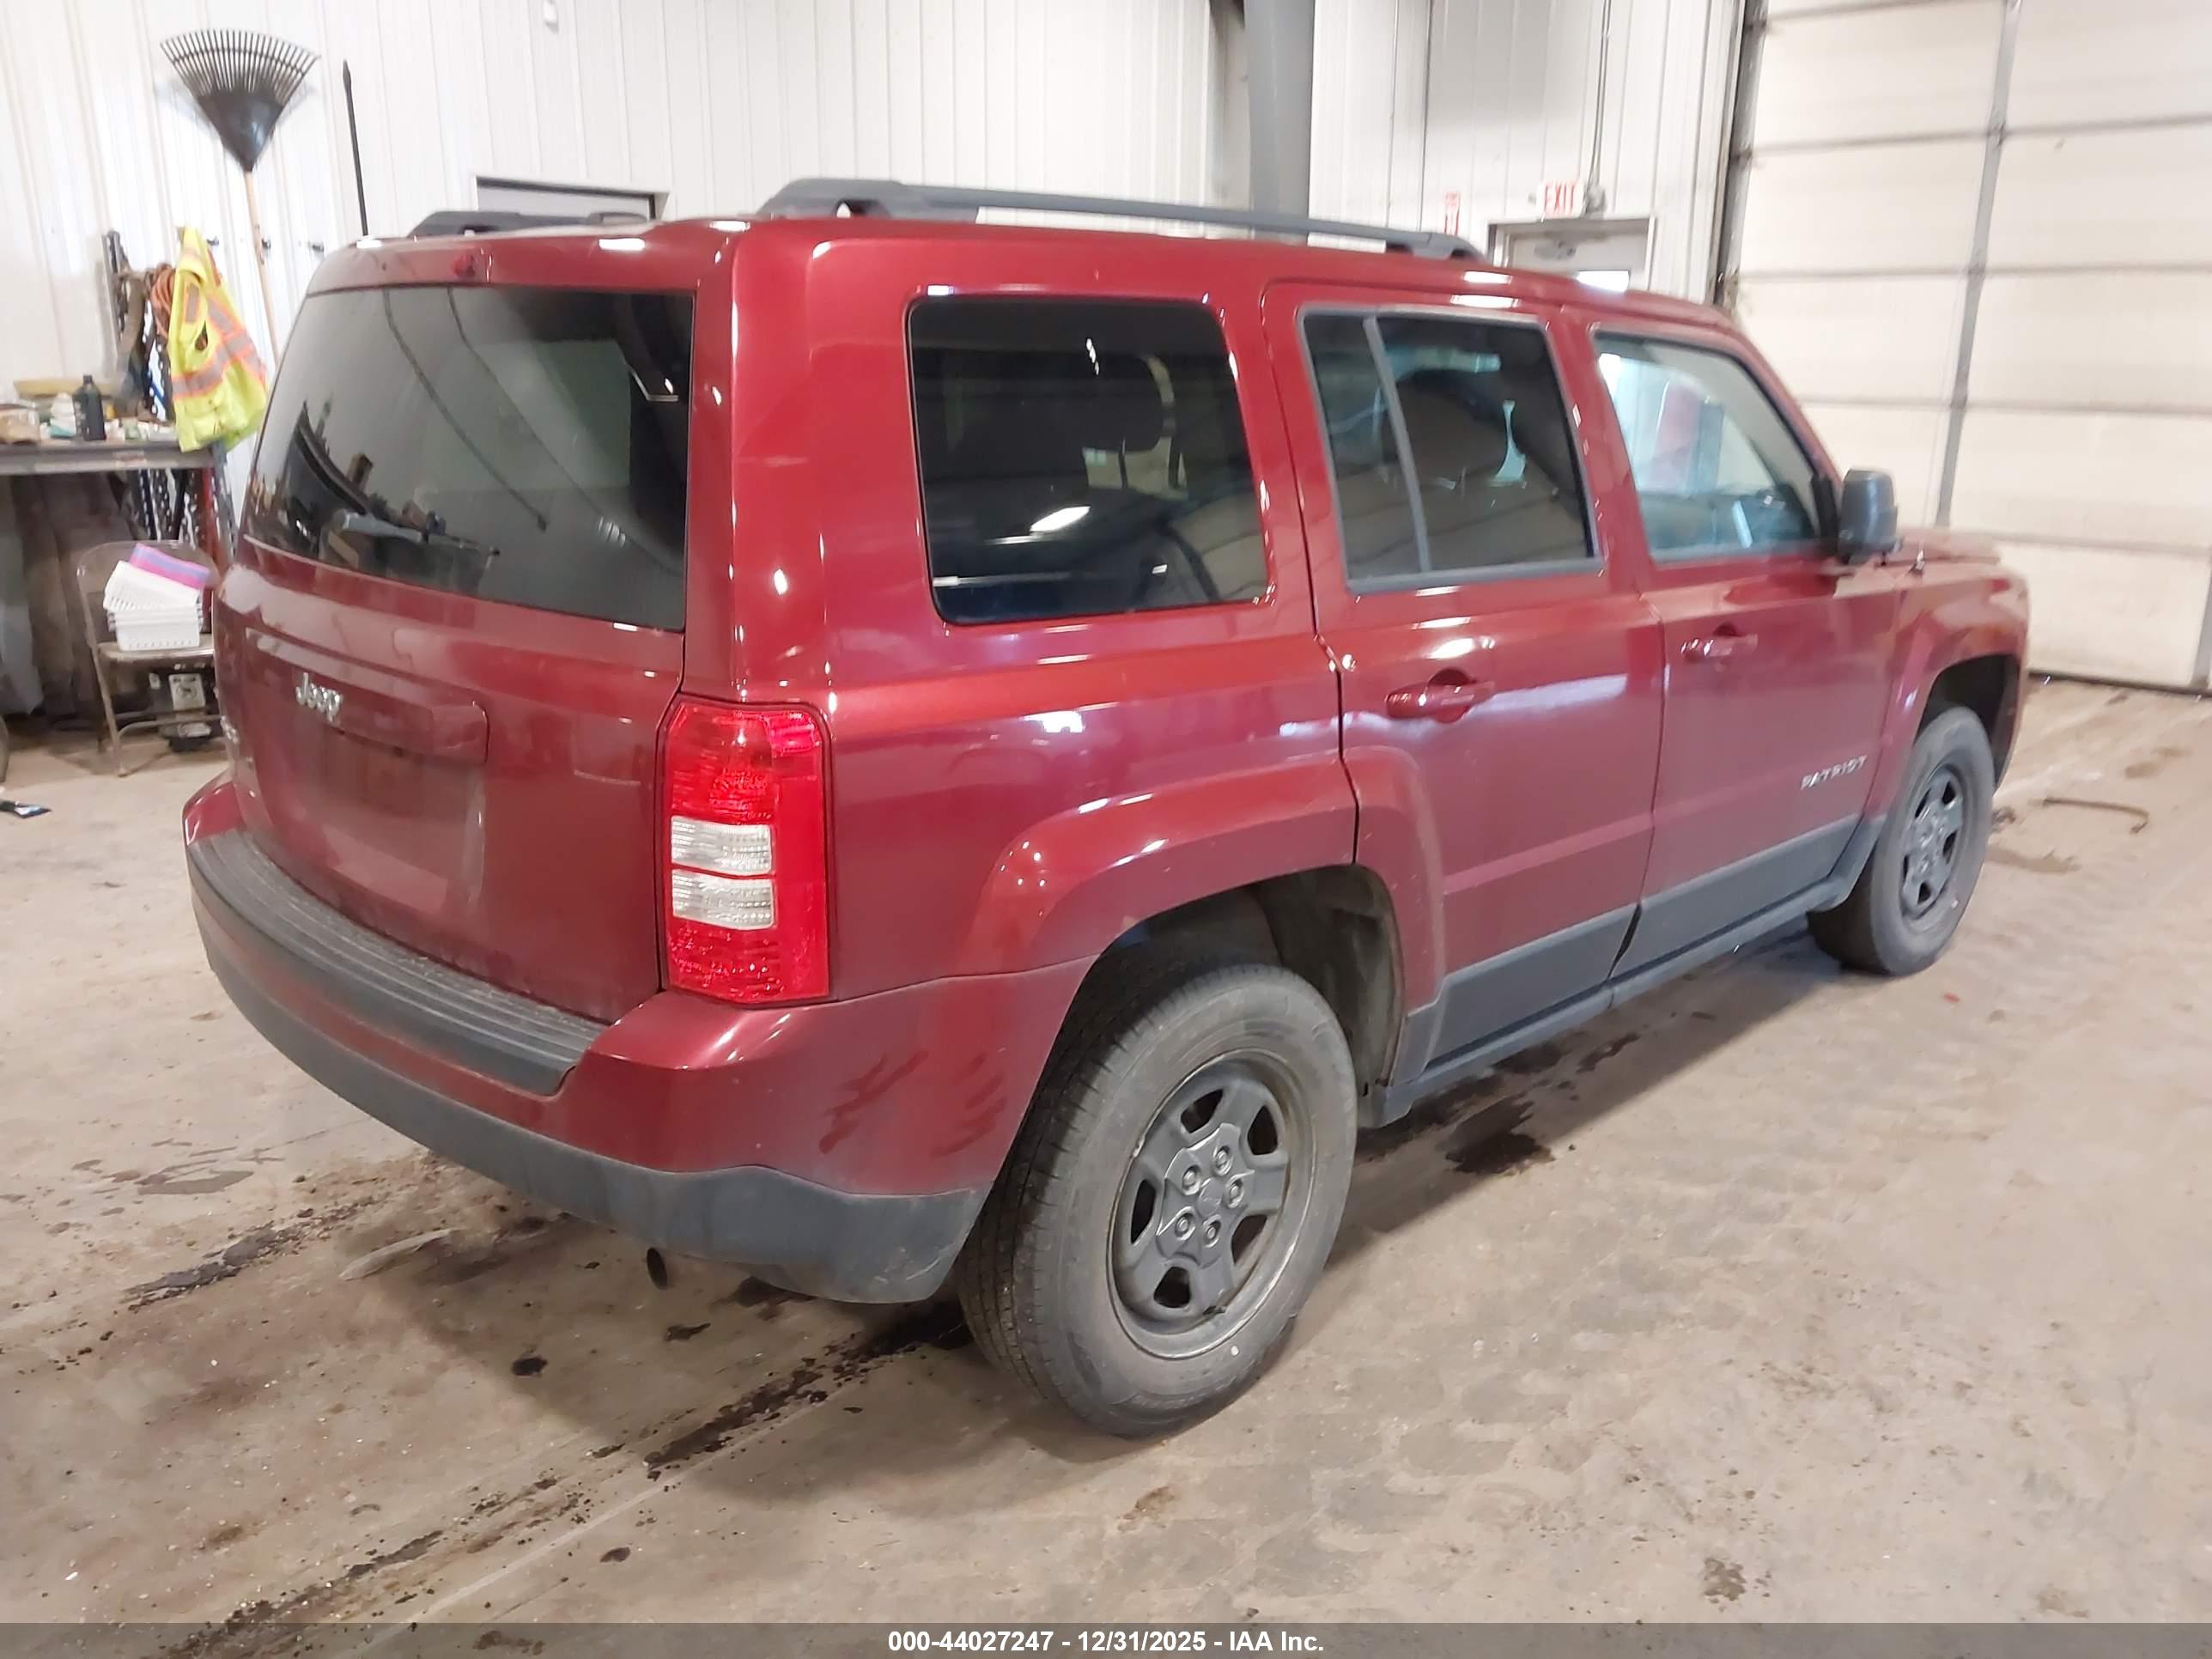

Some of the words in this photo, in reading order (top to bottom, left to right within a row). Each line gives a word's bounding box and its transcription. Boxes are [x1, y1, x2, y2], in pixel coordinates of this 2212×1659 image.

[1544, 182, 1577, 215] EXIT
[295, 672, 343, 722] Jeep
[1801, 755, 1868, 790] PATRIOT
